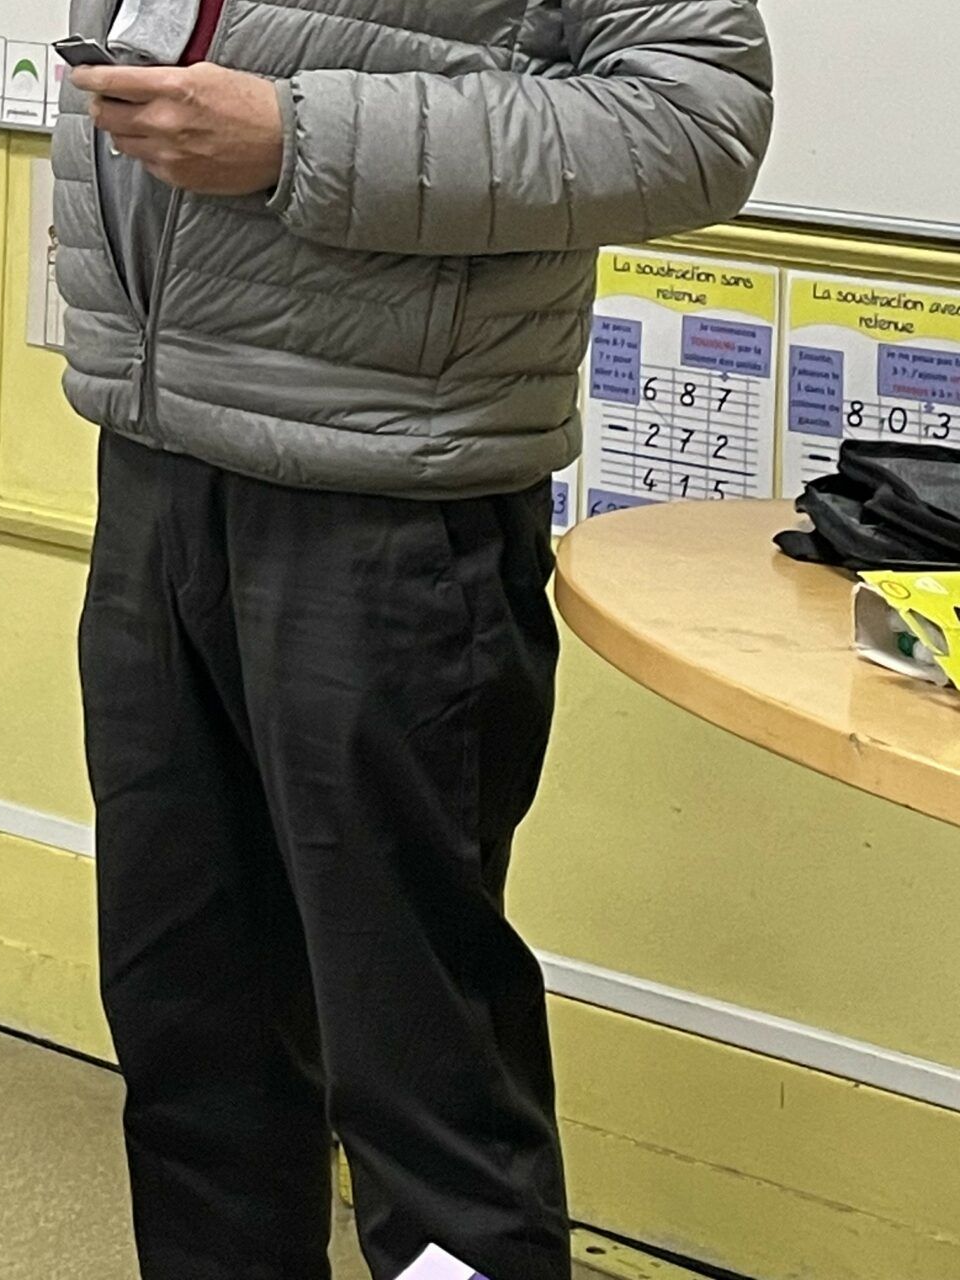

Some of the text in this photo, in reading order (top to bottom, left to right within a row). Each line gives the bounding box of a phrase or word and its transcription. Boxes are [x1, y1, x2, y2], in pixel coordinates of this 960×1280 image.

[613, 255, 754, 290] La soustraction sans
[656, 284, 708, 306] retenue
[812, 283, 832, 301] La
[836, 289, 925, 312] soustraction
[858, 312, 915, 334] retenue
[643, 376, 732, 412] 6 8 7
[847, 400, 864, 428] 8
[888, 406, 908, 434] 0
[932, 412, 952, 439] 3
[644, 423, 660, 449] 2
[680, 428, 696, 453] 7
[712, 434, 729, 460] 2
[642, 467, 658, 492] 4
[680, 474, 691, 498] 1
